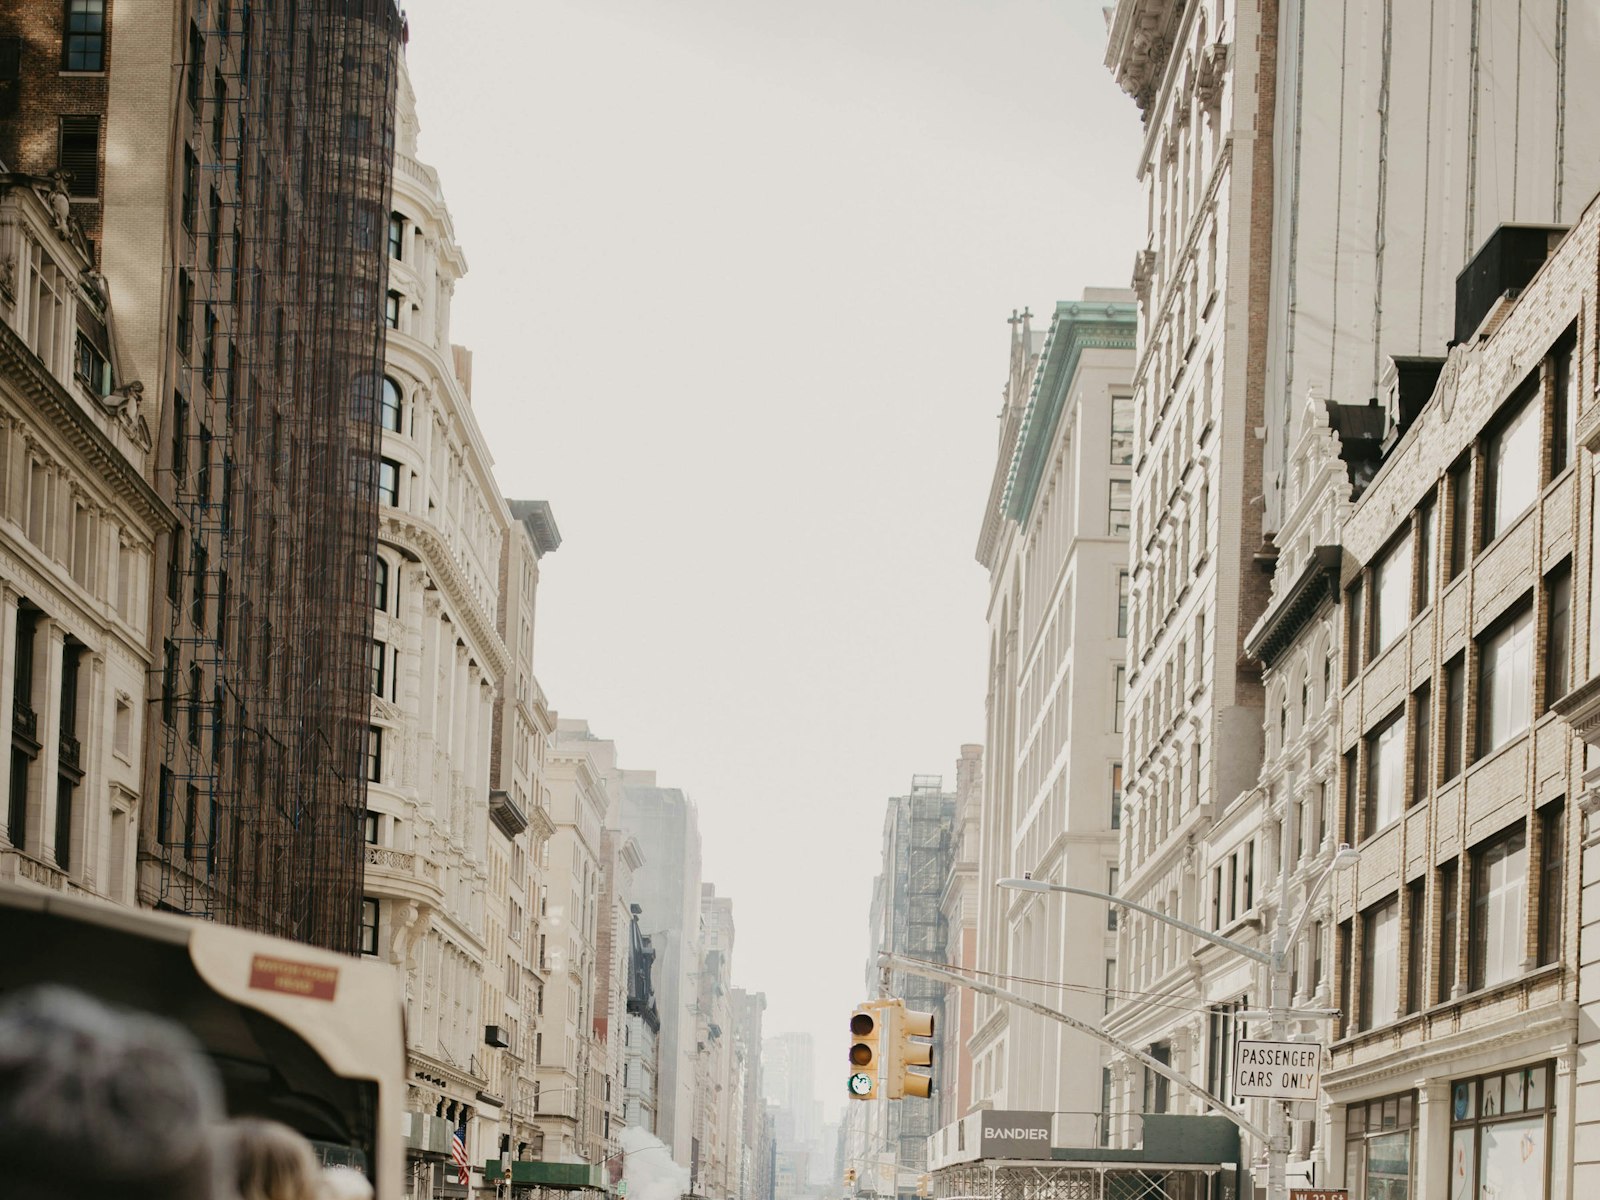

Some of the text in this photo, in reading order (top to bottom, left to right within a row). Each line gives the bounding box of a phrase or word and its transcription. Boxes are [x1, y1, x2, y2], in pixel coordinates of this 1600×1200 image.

[1242, 1048, 1315, 1067] PASSENGER
[1240, 1070, 1314, 1089] CARS ONLY
[984, 1127, 1049, 1140] BANDIER
